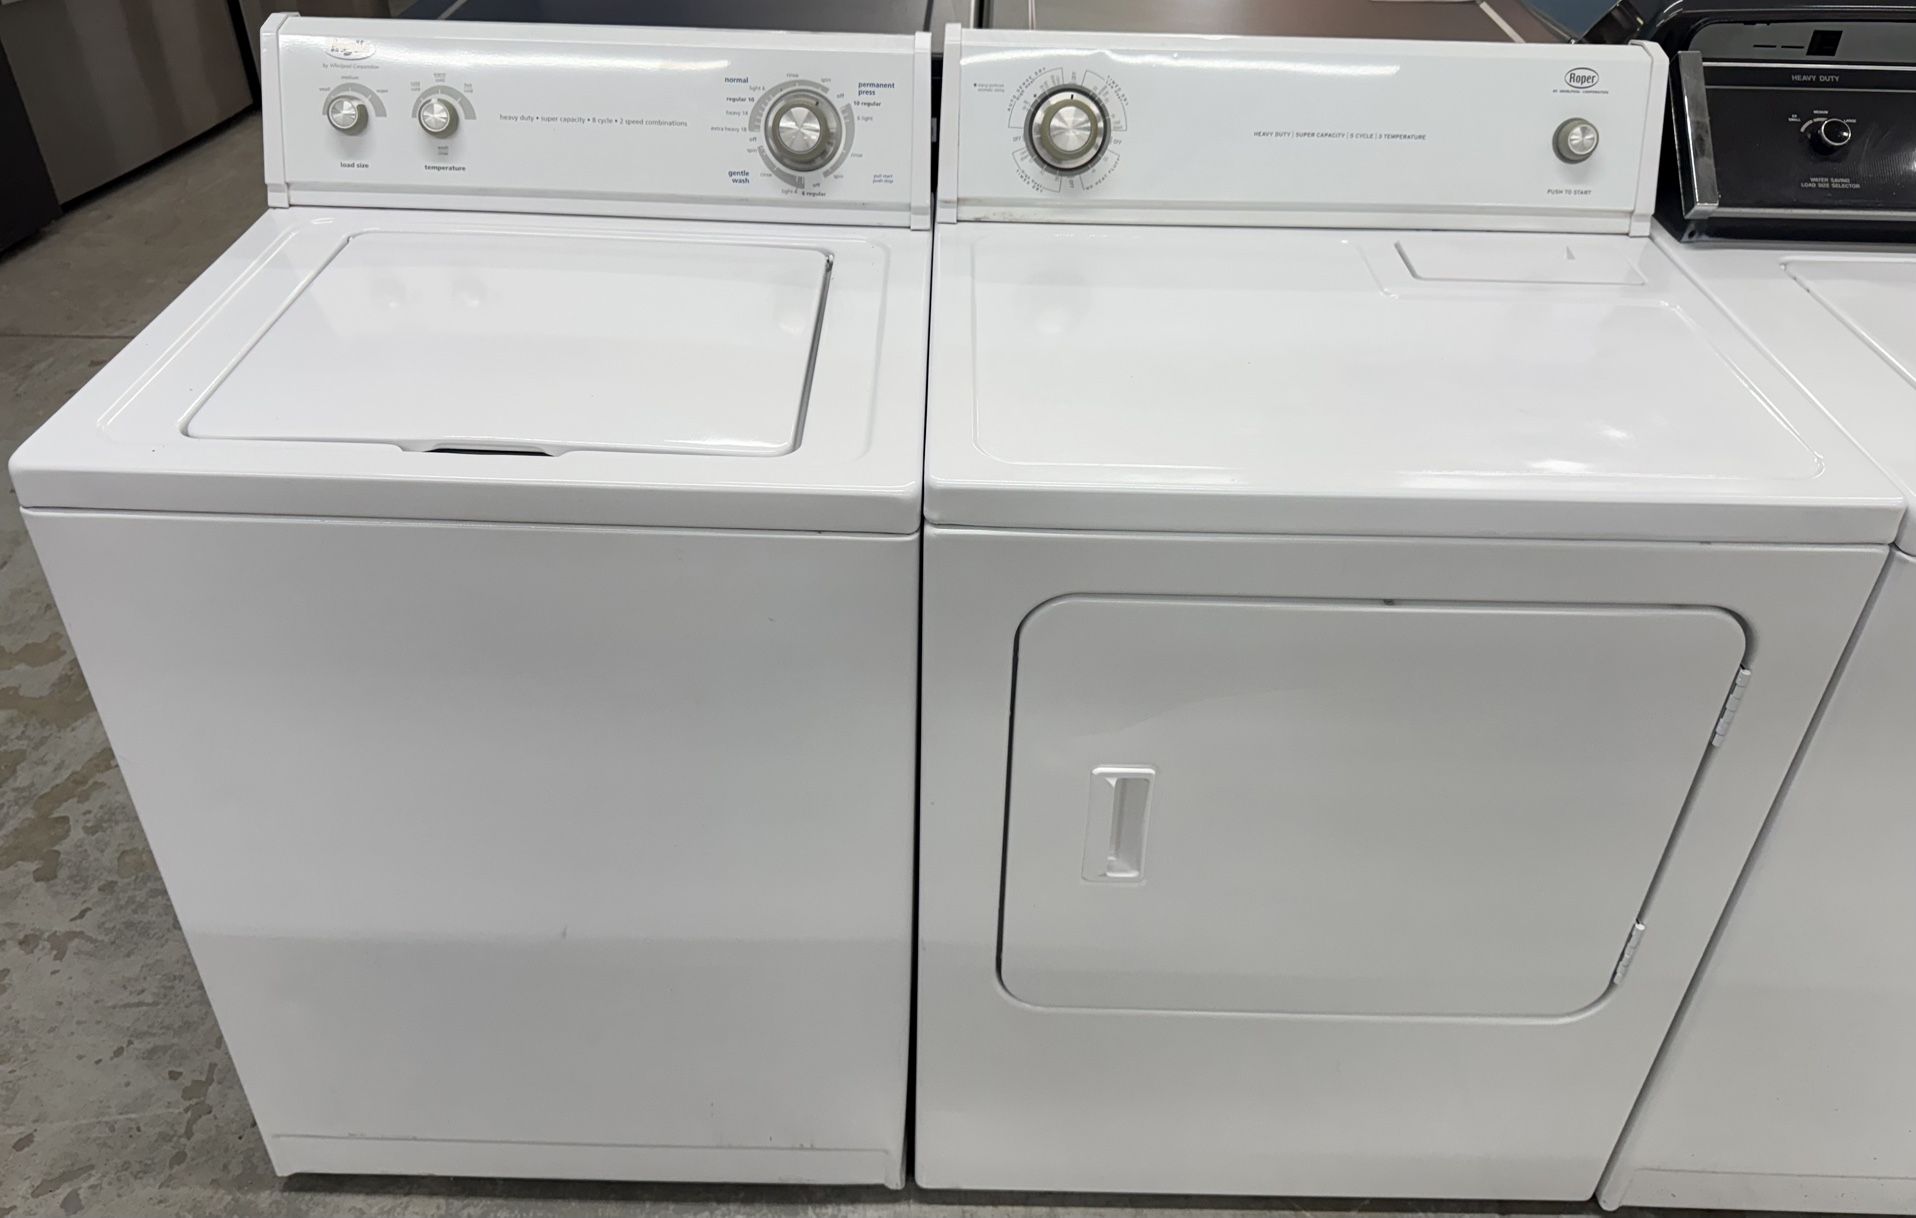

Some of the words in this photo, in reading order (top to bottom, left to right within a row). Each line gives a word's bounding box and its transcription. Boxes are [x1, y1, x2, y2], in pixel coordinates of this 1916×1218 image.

[724, 76, 749, 84] normal
[1569, 72, 1596, 85] Roper
[1792, 74, 1816, 82] HEAVY
[858, 82, 895, 90] permanent
[499, 114, 518, 122] heavy
[559, 116, 586, 124] capacity
[597, 117, 613, 125] cycle
[645, 119, 688, 128] combinations
[340, 161, 355, 169] load
[728, 170, 750, 178] gentle
